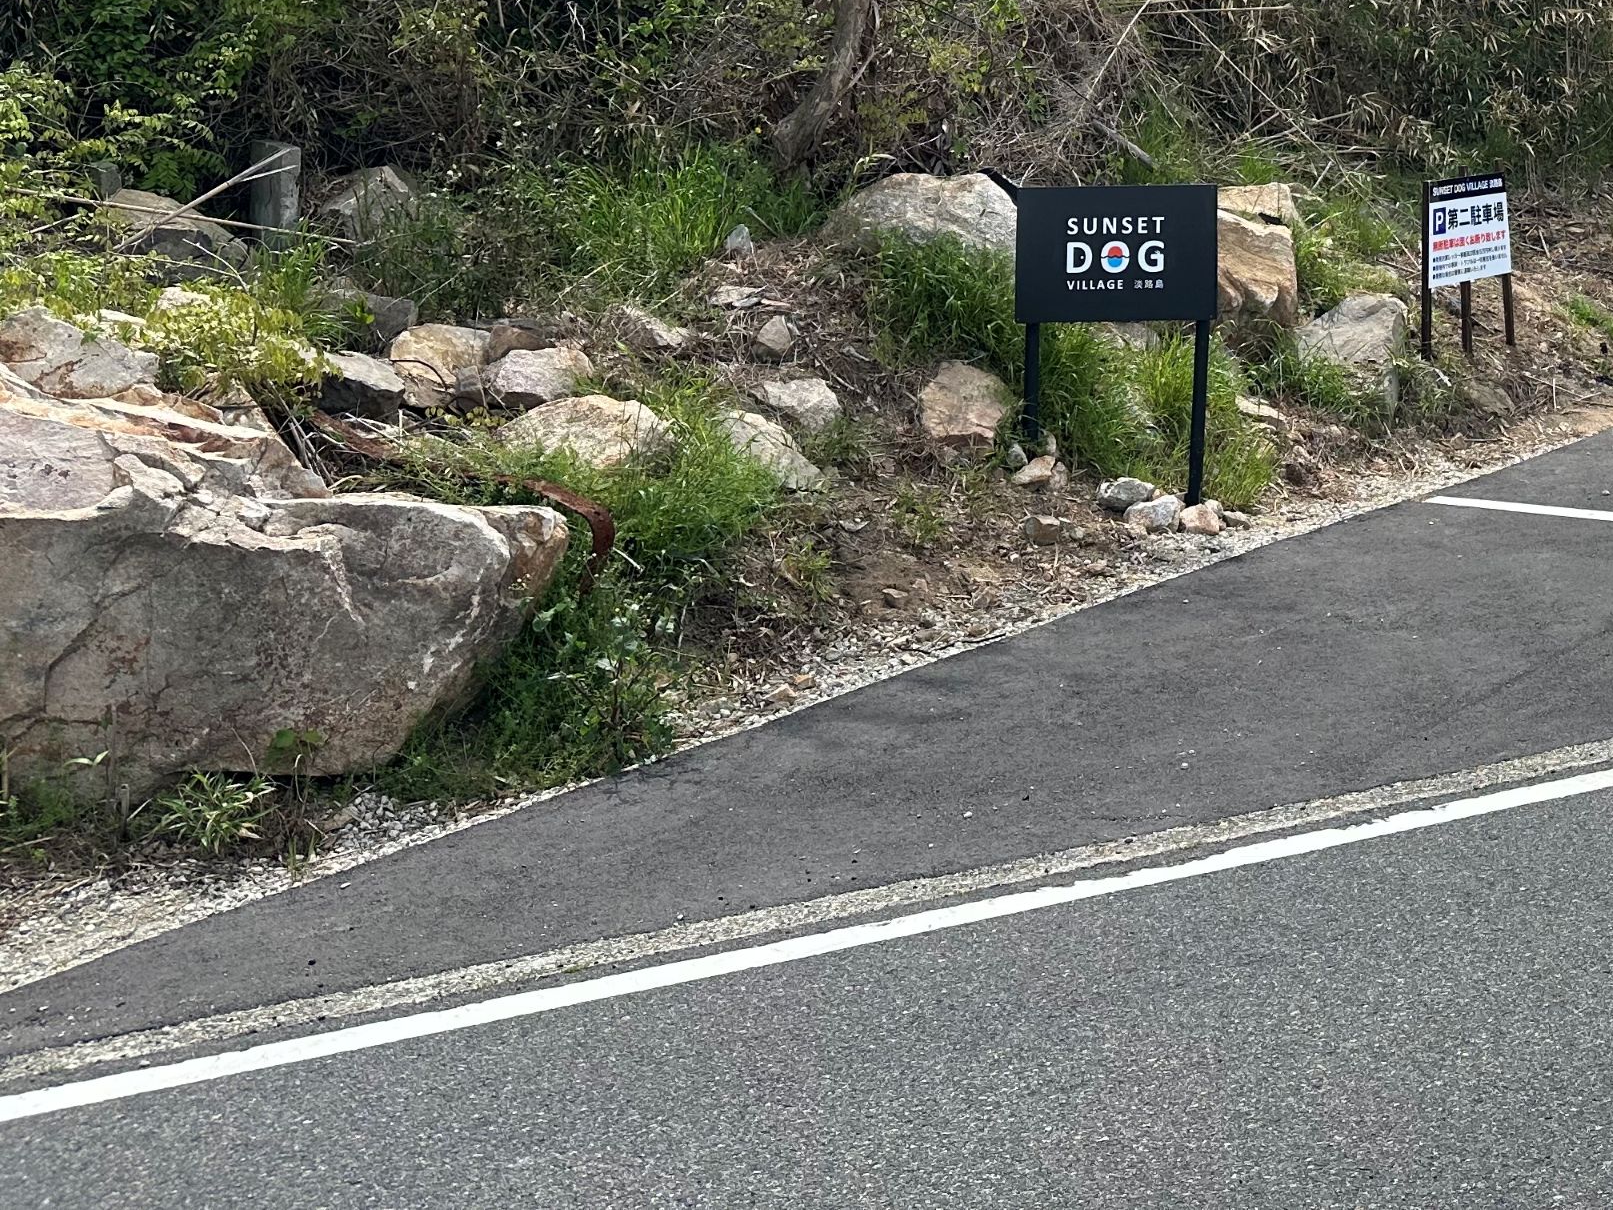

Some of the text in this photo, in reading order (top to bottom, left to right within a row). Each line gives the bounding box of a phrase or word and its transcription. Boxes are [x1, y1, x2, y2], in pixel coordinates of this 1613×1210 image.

[1432, 185, 1454, 197] SUNSET
[1454, 183, 1466, 194] DOG
[1466, 179, 1489, 191] VILLAGE
[1066, 217, 1165, 235] SUNSET
[1434, 201, 1504, 233] P 第二駐車場
[1066, 240, 1165, 274] DOG
[1066, 279, 1164, 290] VILLAGE 淡路島
